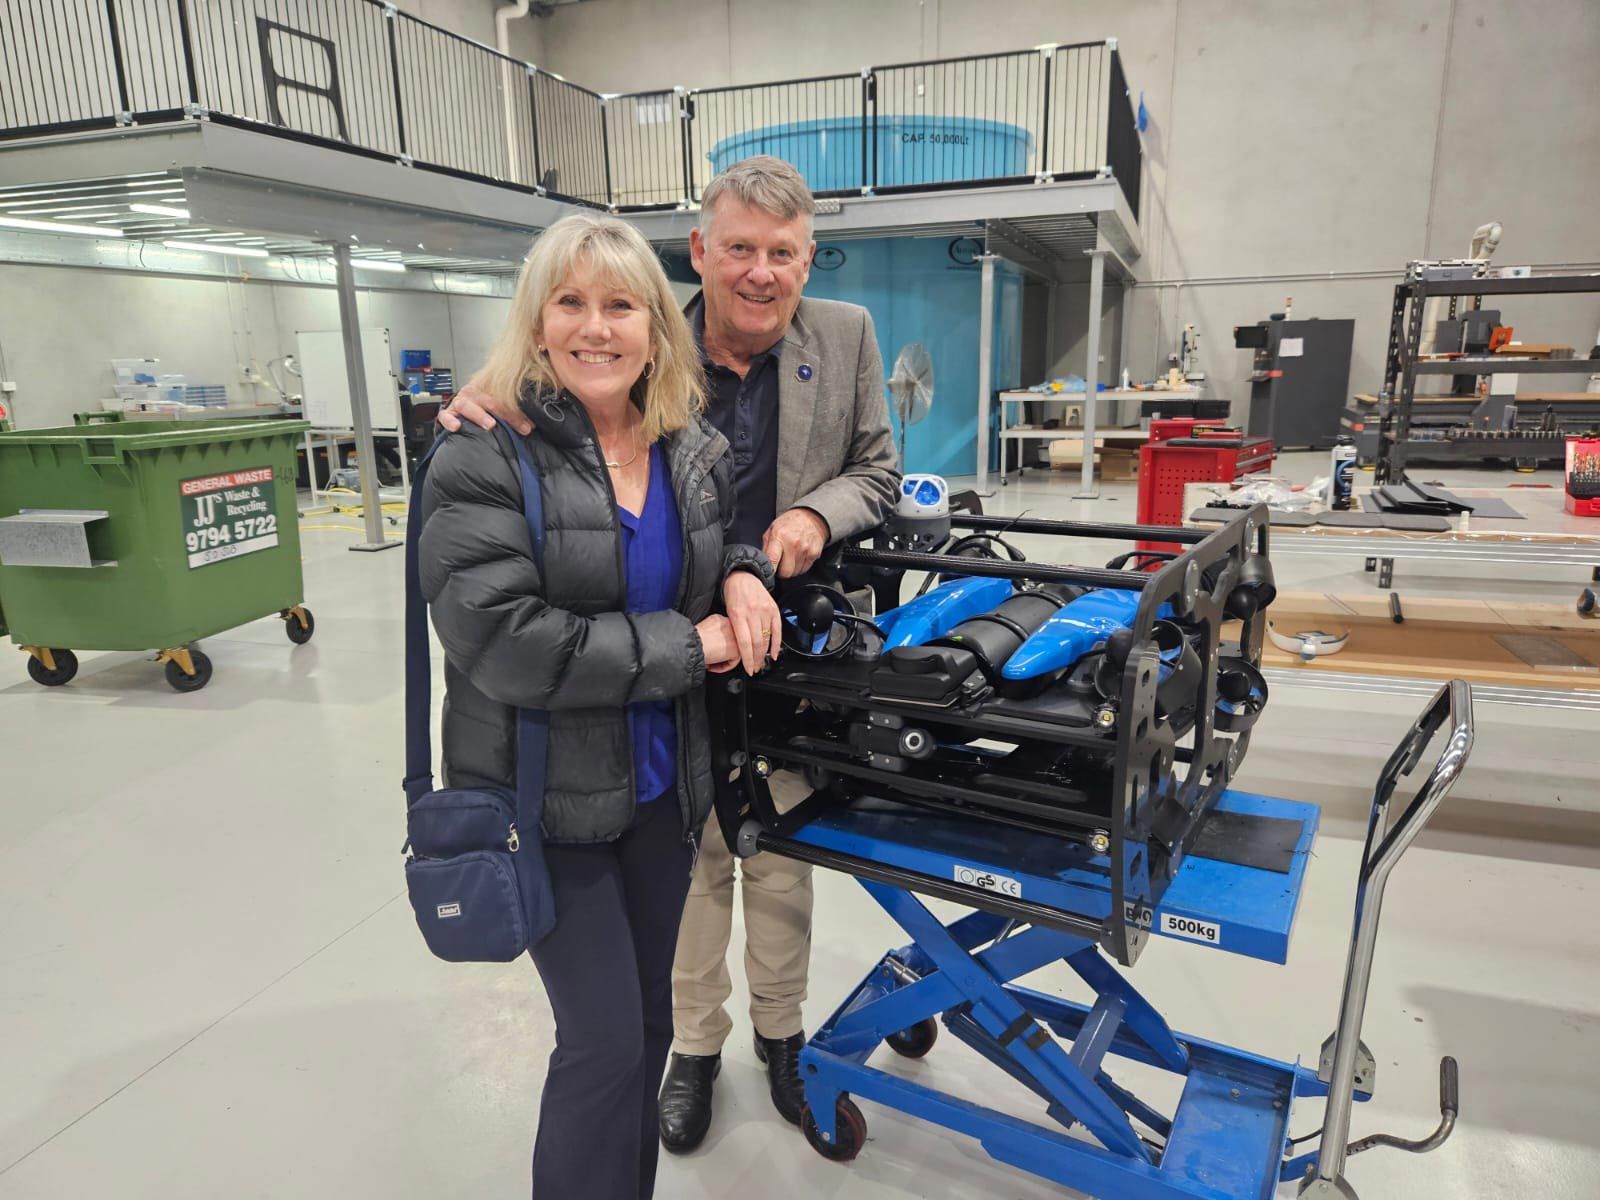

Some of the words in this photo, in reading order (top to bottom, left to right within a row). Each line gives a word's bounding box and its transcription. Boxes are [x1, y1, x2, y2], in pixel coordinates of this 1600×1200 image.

[183, 478, 232, 494] GENERAL
[235, 469, 271, 483] WASTE
[224, 490, 250, 502] Waste
[251, 486, 260, 498] &
[227, 501, 267, 515] Recycling
[186, 524, 231, 552] 9794
[235, 514, 277, 540] 5722
[977, 875, 995, 888] GS
[1169, 917, 1216, 940] 500kg
